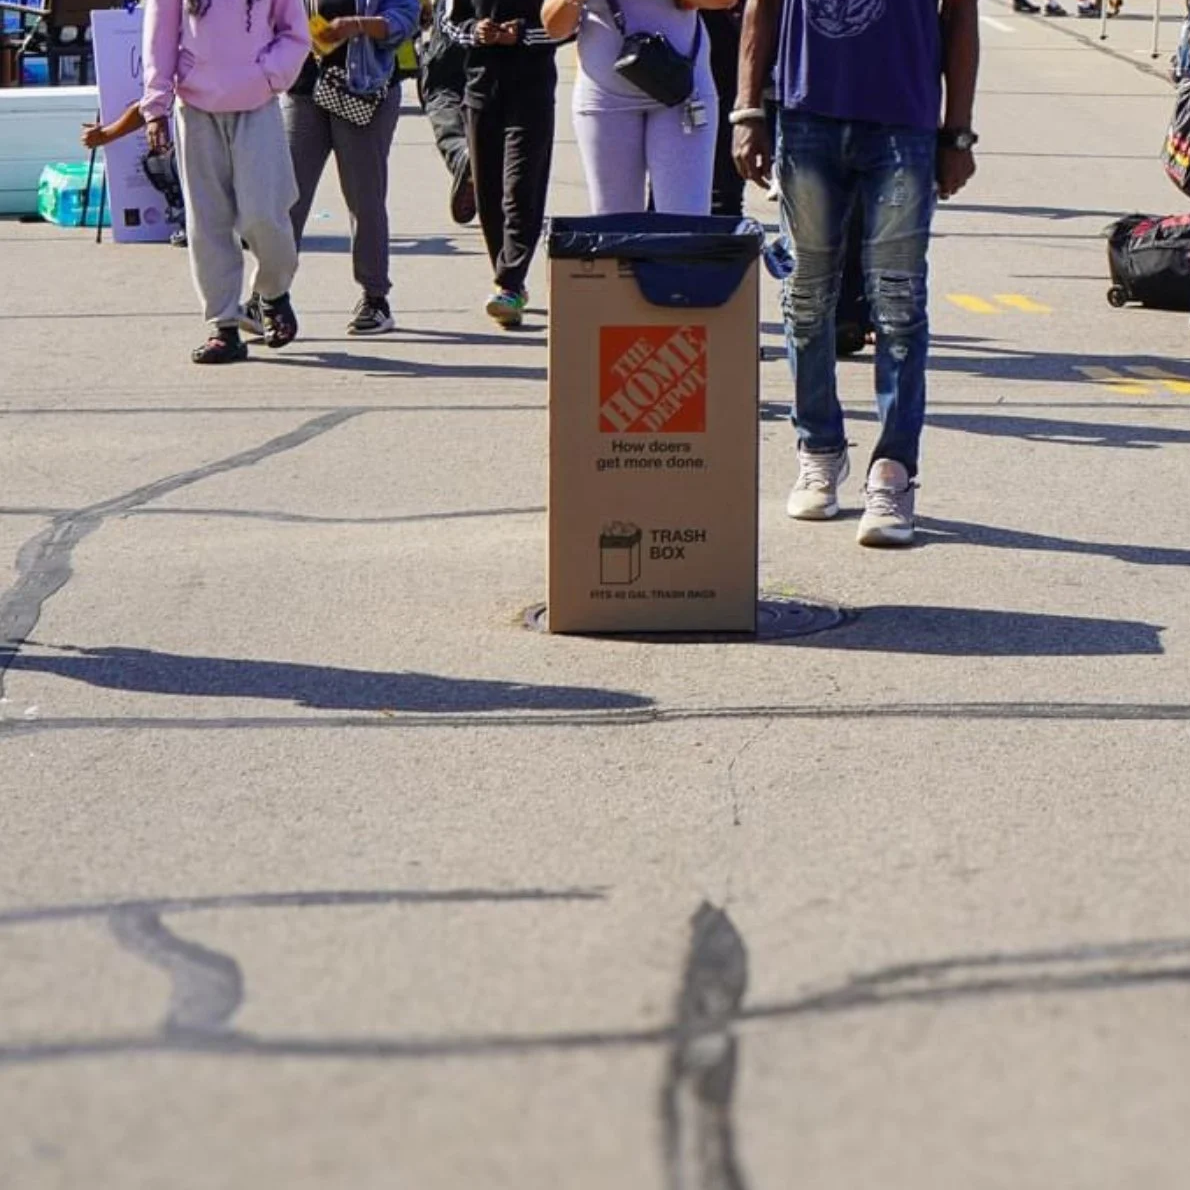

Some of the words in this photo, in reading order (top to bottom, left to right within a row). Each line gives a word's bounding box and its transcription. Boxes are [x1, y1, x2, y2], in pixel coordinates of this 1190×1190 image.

[611, 336, 653, 378] THE
[601, 325, 706, 432] HOME
[643, 364, 706, 432] DEPOT
[612, 440, 645, 453] How
[650, 440, 691, 453] doers
[597, 457, 621, 471] get
[624, 458, 662, 469] more
[650, 529, 706, 542] TRASH
[650, 546, 685, 559] BOX
